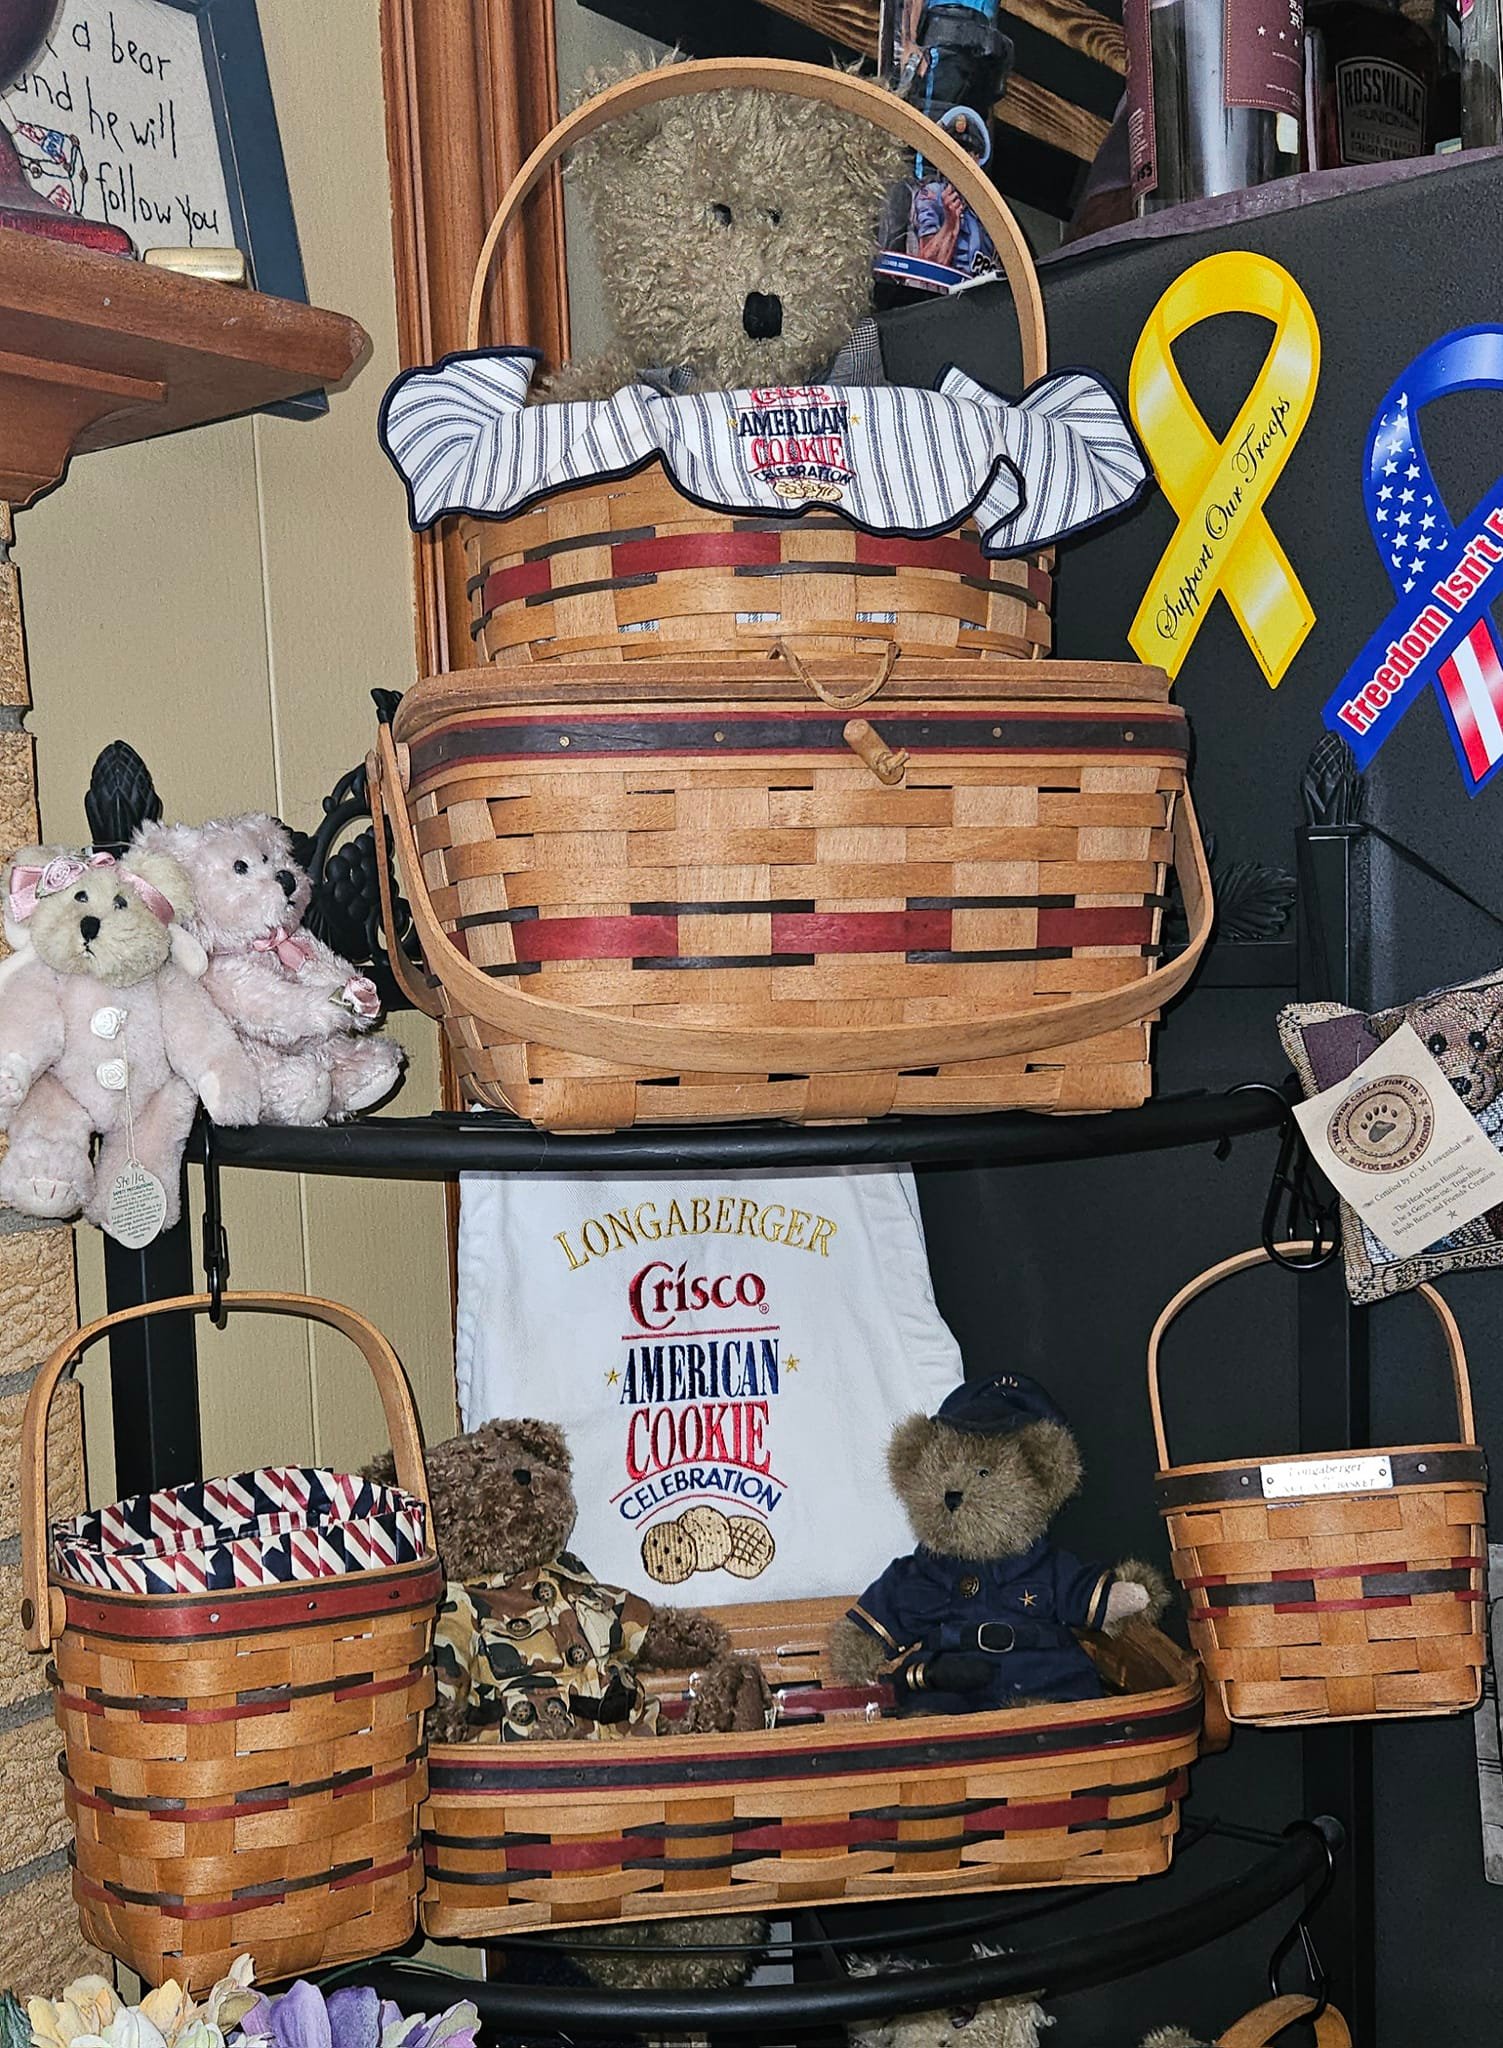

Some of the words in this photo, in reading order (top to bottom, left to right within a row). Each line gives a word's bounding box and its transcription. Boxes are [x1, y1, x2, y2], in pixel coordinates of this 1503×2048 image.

[72, 21, 91, 51] a
[110, 11, 171, 80] bear
[86, 76, 124, 152] he
[130, 100, 176, 158] will
[1343, 67, 1421, 126] ROSSVILLE
[95, 162, 171, 224] follow
[738, 406, 849, 437] AMERICAN
[751, 386, 825, 405] Crisco
[751, 437, 847, 469] COOKIE
[753, 463, 854, 485] CELEBRATION
[1156, 543, 1214, 640] Support
[1205, 486, 1243, 540] Our
[1231, 396, 1291, 483] Troops
[1337, 604, 1453, 736] Freedom
[1431, 534, 1503, 613] Isn't
[1350, 1079, 1404, 1102] COLLECTION
[1380, 1156, 1410, 1171] BEARS
[553, 1196, 839, 1271] LONGABERGER
[628, 1259, 767, 1331] Crisco
[620, 1338, 779, 1404] AMERICAN
[625, 1400, 771, 1480] COOKIE
[619, 1467, 783, 1521] CELEBRATION
